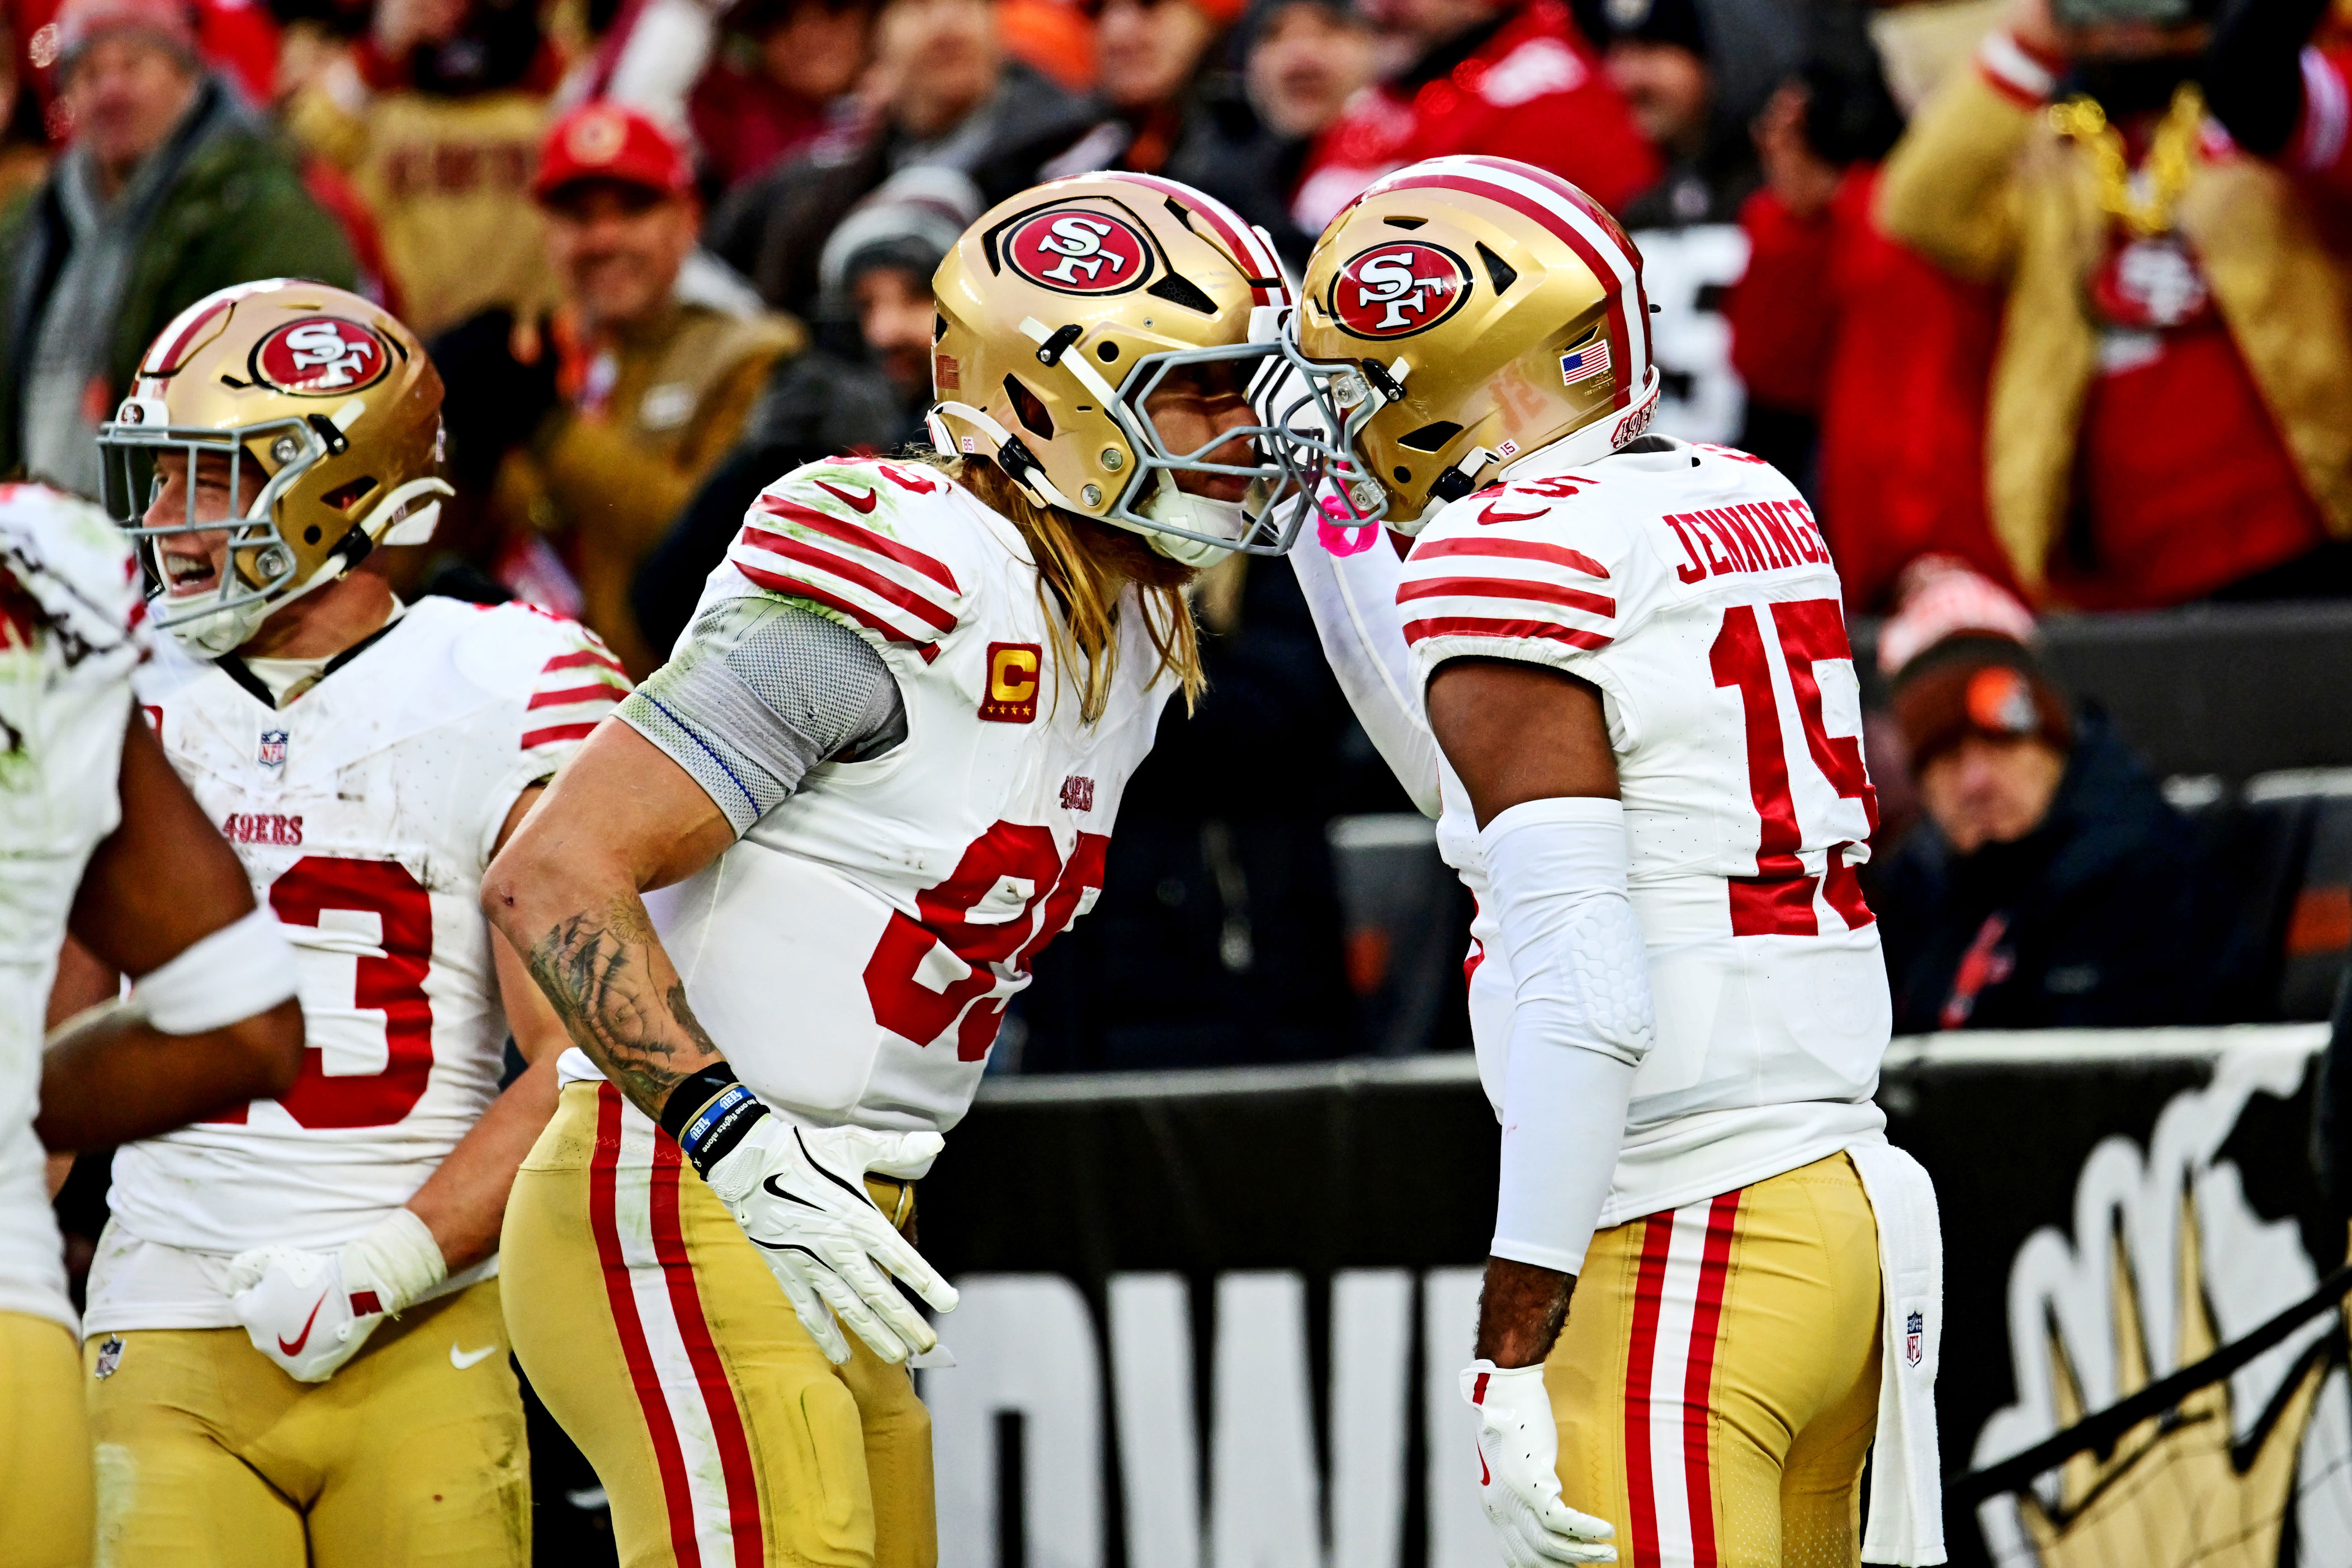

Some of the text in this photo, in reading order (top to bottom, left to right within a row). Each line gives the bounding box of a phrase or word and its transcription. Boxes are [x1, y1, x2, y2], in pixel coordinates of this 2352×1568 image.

[1037, 217, 1126, 285] SF
[1358, 252, 1443, 329] SF
[286, 322, 373, 389] SF
[963, 438, 973, 451] 85
[1500, 442, 1515, 455] 15
[1662, 499, 1829, 584] JENNINGS
[992, 650, 1037, 702] C
[1709, 598, 1879, 937] 15
[223, 813, 303, 846] 49ERS
[863, 820, 1112, 1062] 85
[717, 1113, 738, 1133] fights
[734, 1103, 748, 1114] one
[702, 1131, 719, 1153] alone
[1907, 1335, 1920, 1362] NFL
